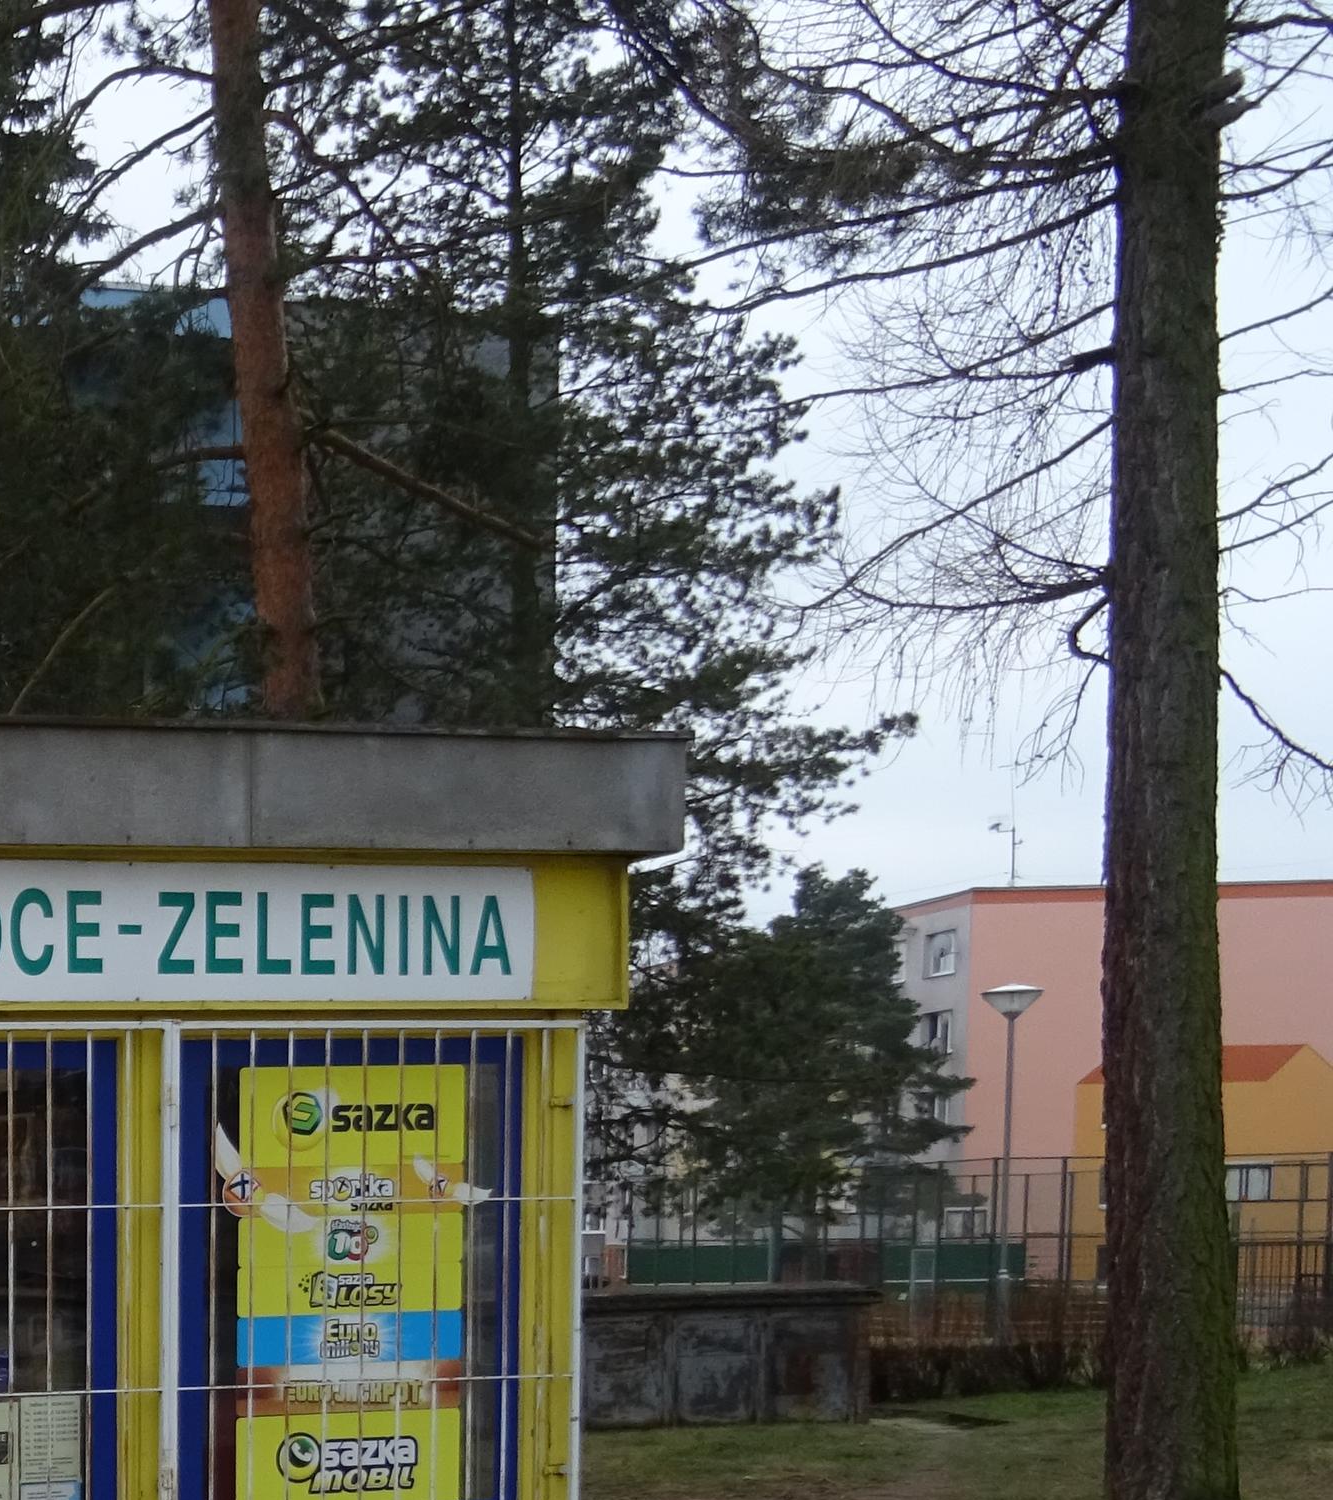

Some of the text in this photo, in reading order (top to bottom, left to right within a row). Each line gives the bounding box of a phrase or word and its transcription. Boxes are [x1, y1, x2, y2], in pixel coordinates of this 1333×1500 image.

[331, 1104, 435, 1132] sazka
[337, 1285, 399, 1306] LOSY
[325, 1318, 378, 1342] Euro
[322, 1437, 417, 1467] sazka
[311, 1465, 415, 1492] MOBIL
